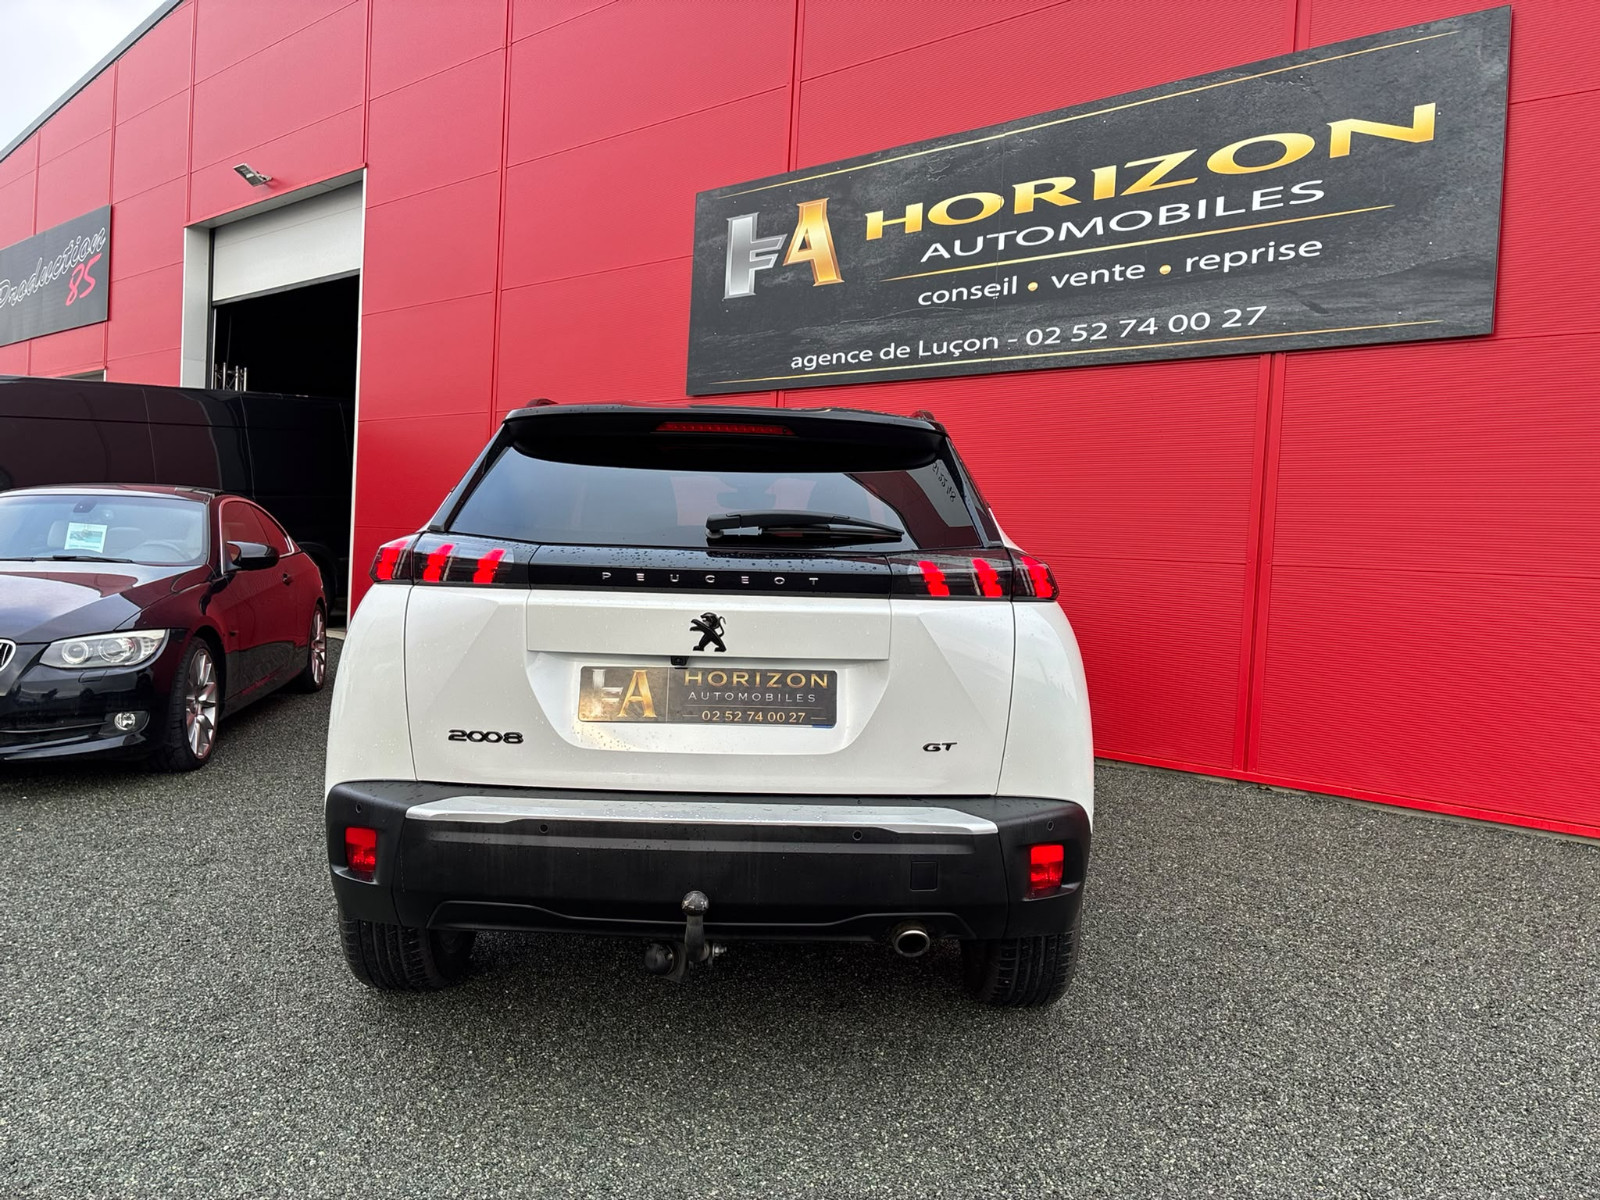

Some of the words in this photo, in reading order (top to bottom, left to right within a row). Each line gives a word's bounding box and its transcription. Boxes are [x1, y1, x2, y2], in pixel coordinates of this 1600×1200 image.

[865, 102, 1436, 241] HORIZON
[920, 180, 1325, 263] AUTOMOBILES
[65, 253, 102, 306] 85
[918, 276, 1018, 306] conseil
[1051, 263, 1146, 289] vente
[1185, 240, 1323, 273] reprise
[790, 349, 873, 371] agence
[879, 342, 911, 359] de
[918, 336, 999, 357] Luçon
[1025, 326, 1062, 346] 02
[1070, 322, 1108, 343] 52
[1119, 317, 1159, 338] 74
[1167, 312, 1211, 333] 00
[1223, 305, 1268, 328] 27
[602, 572, 819, 585] PEUGEOT
[684, 670, 829, 689] HORIZON
[688, 691, 816, 703] AUTOMOBILES
[701, 710, 720, 721] 02
[725, 711, 742, 722] 52
[747, 711, 764, 722] 74
[767, 712, 786, 723] 00
[789, 712, 806, 723] 27
[448, 729, 524, 744] 2008
[923, 742, 957, 752] GT
